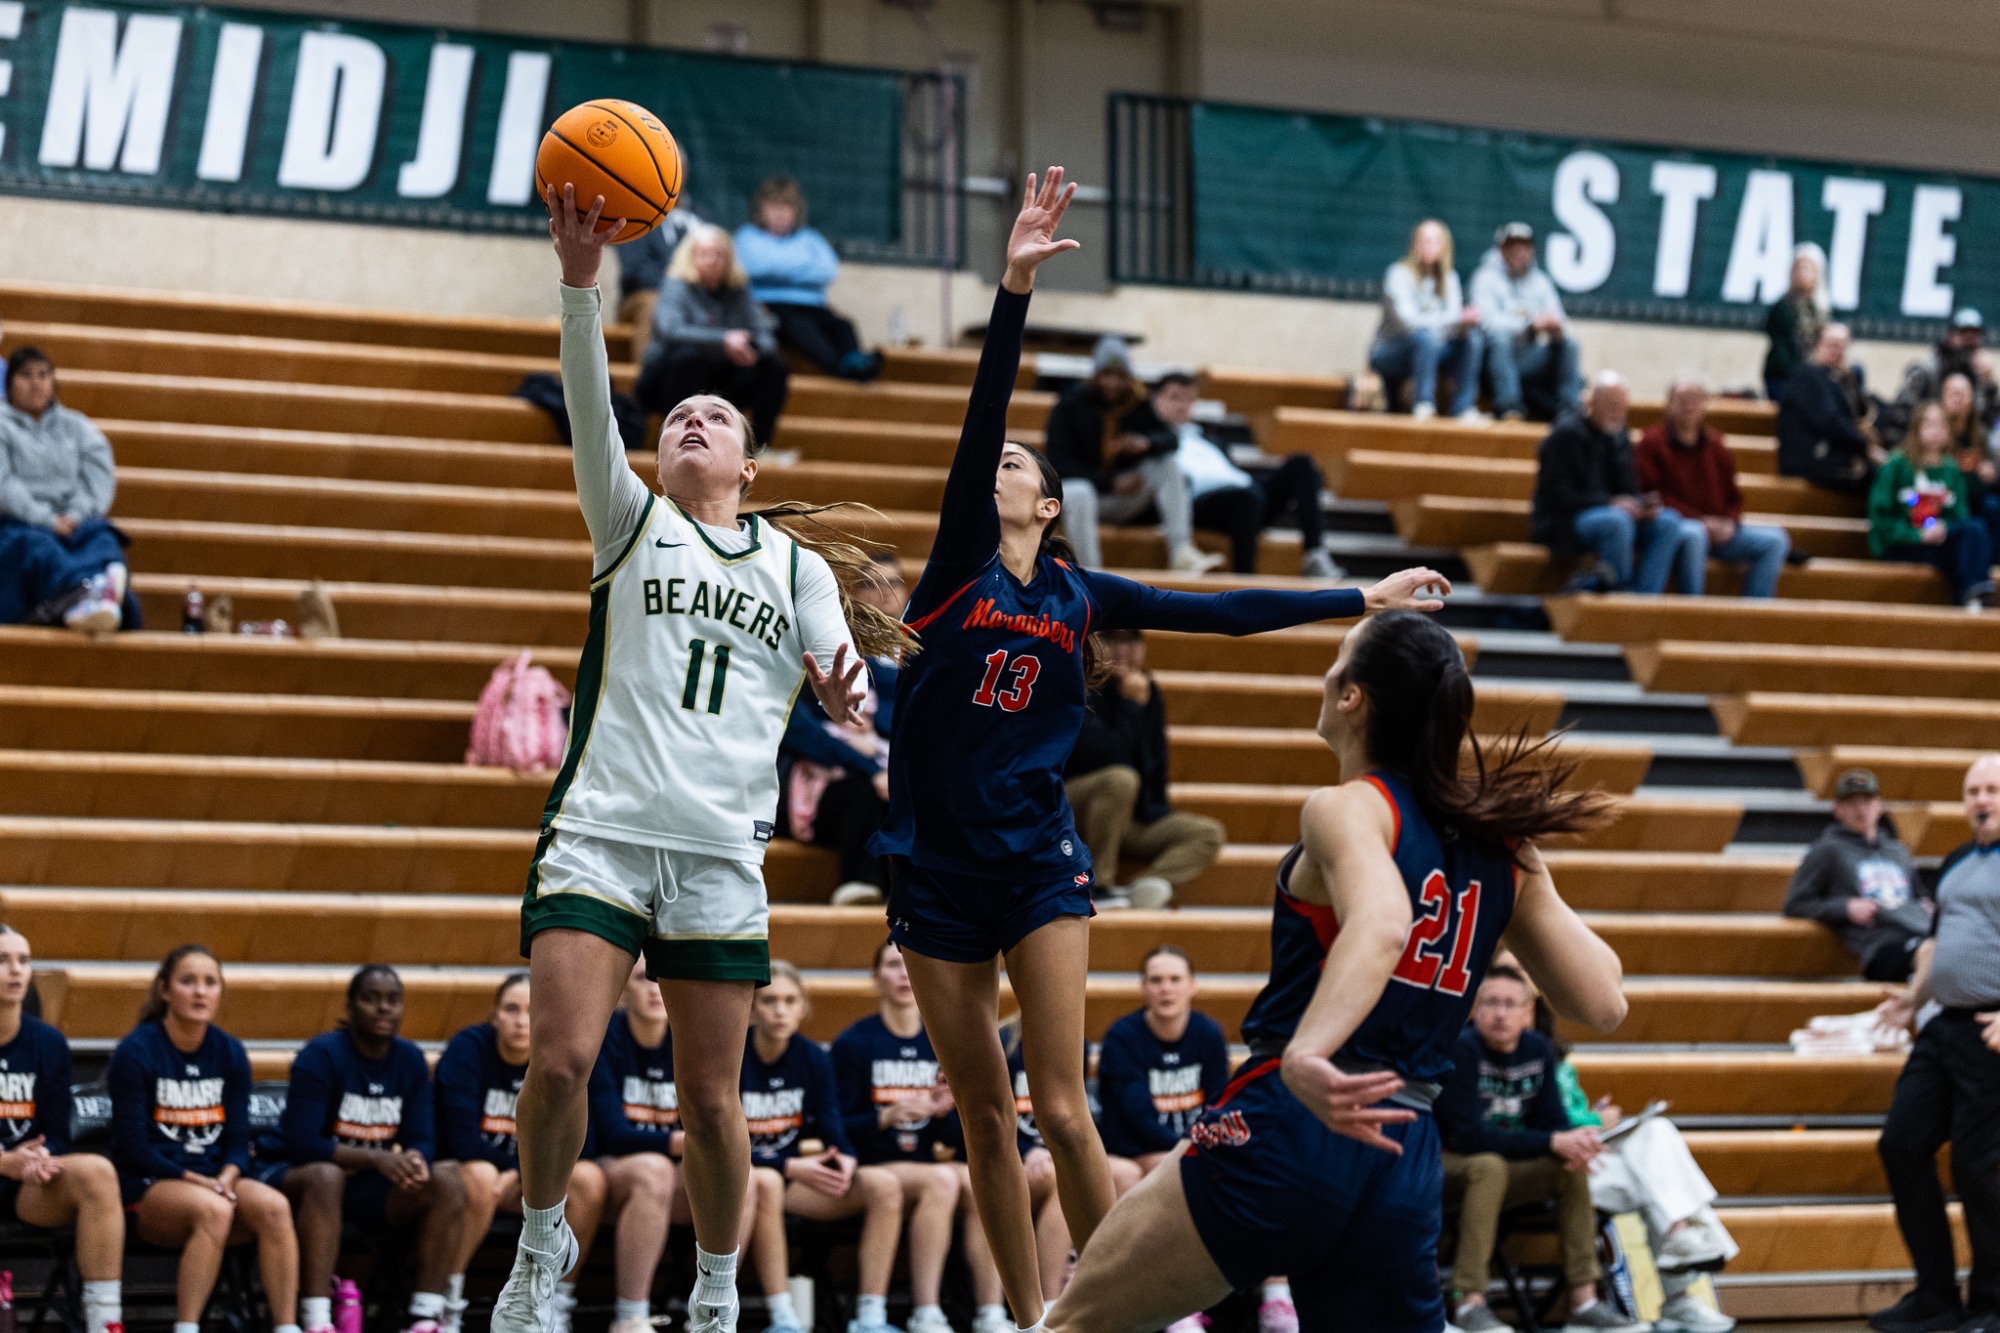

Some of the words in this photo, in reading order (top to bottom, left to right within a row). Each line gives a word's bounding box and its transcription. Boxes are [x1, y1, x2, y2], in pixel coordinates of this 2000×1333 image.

[1545, 149, 1963, 318] STATE
[643, 578, 791, 651] BEAVERS
[962, 598, 1075, 653] Marauders
[680, 637, 733, 717] 11
[972, 649, 1041, 712] 13
[1391, 868, 1482, 997] 21
